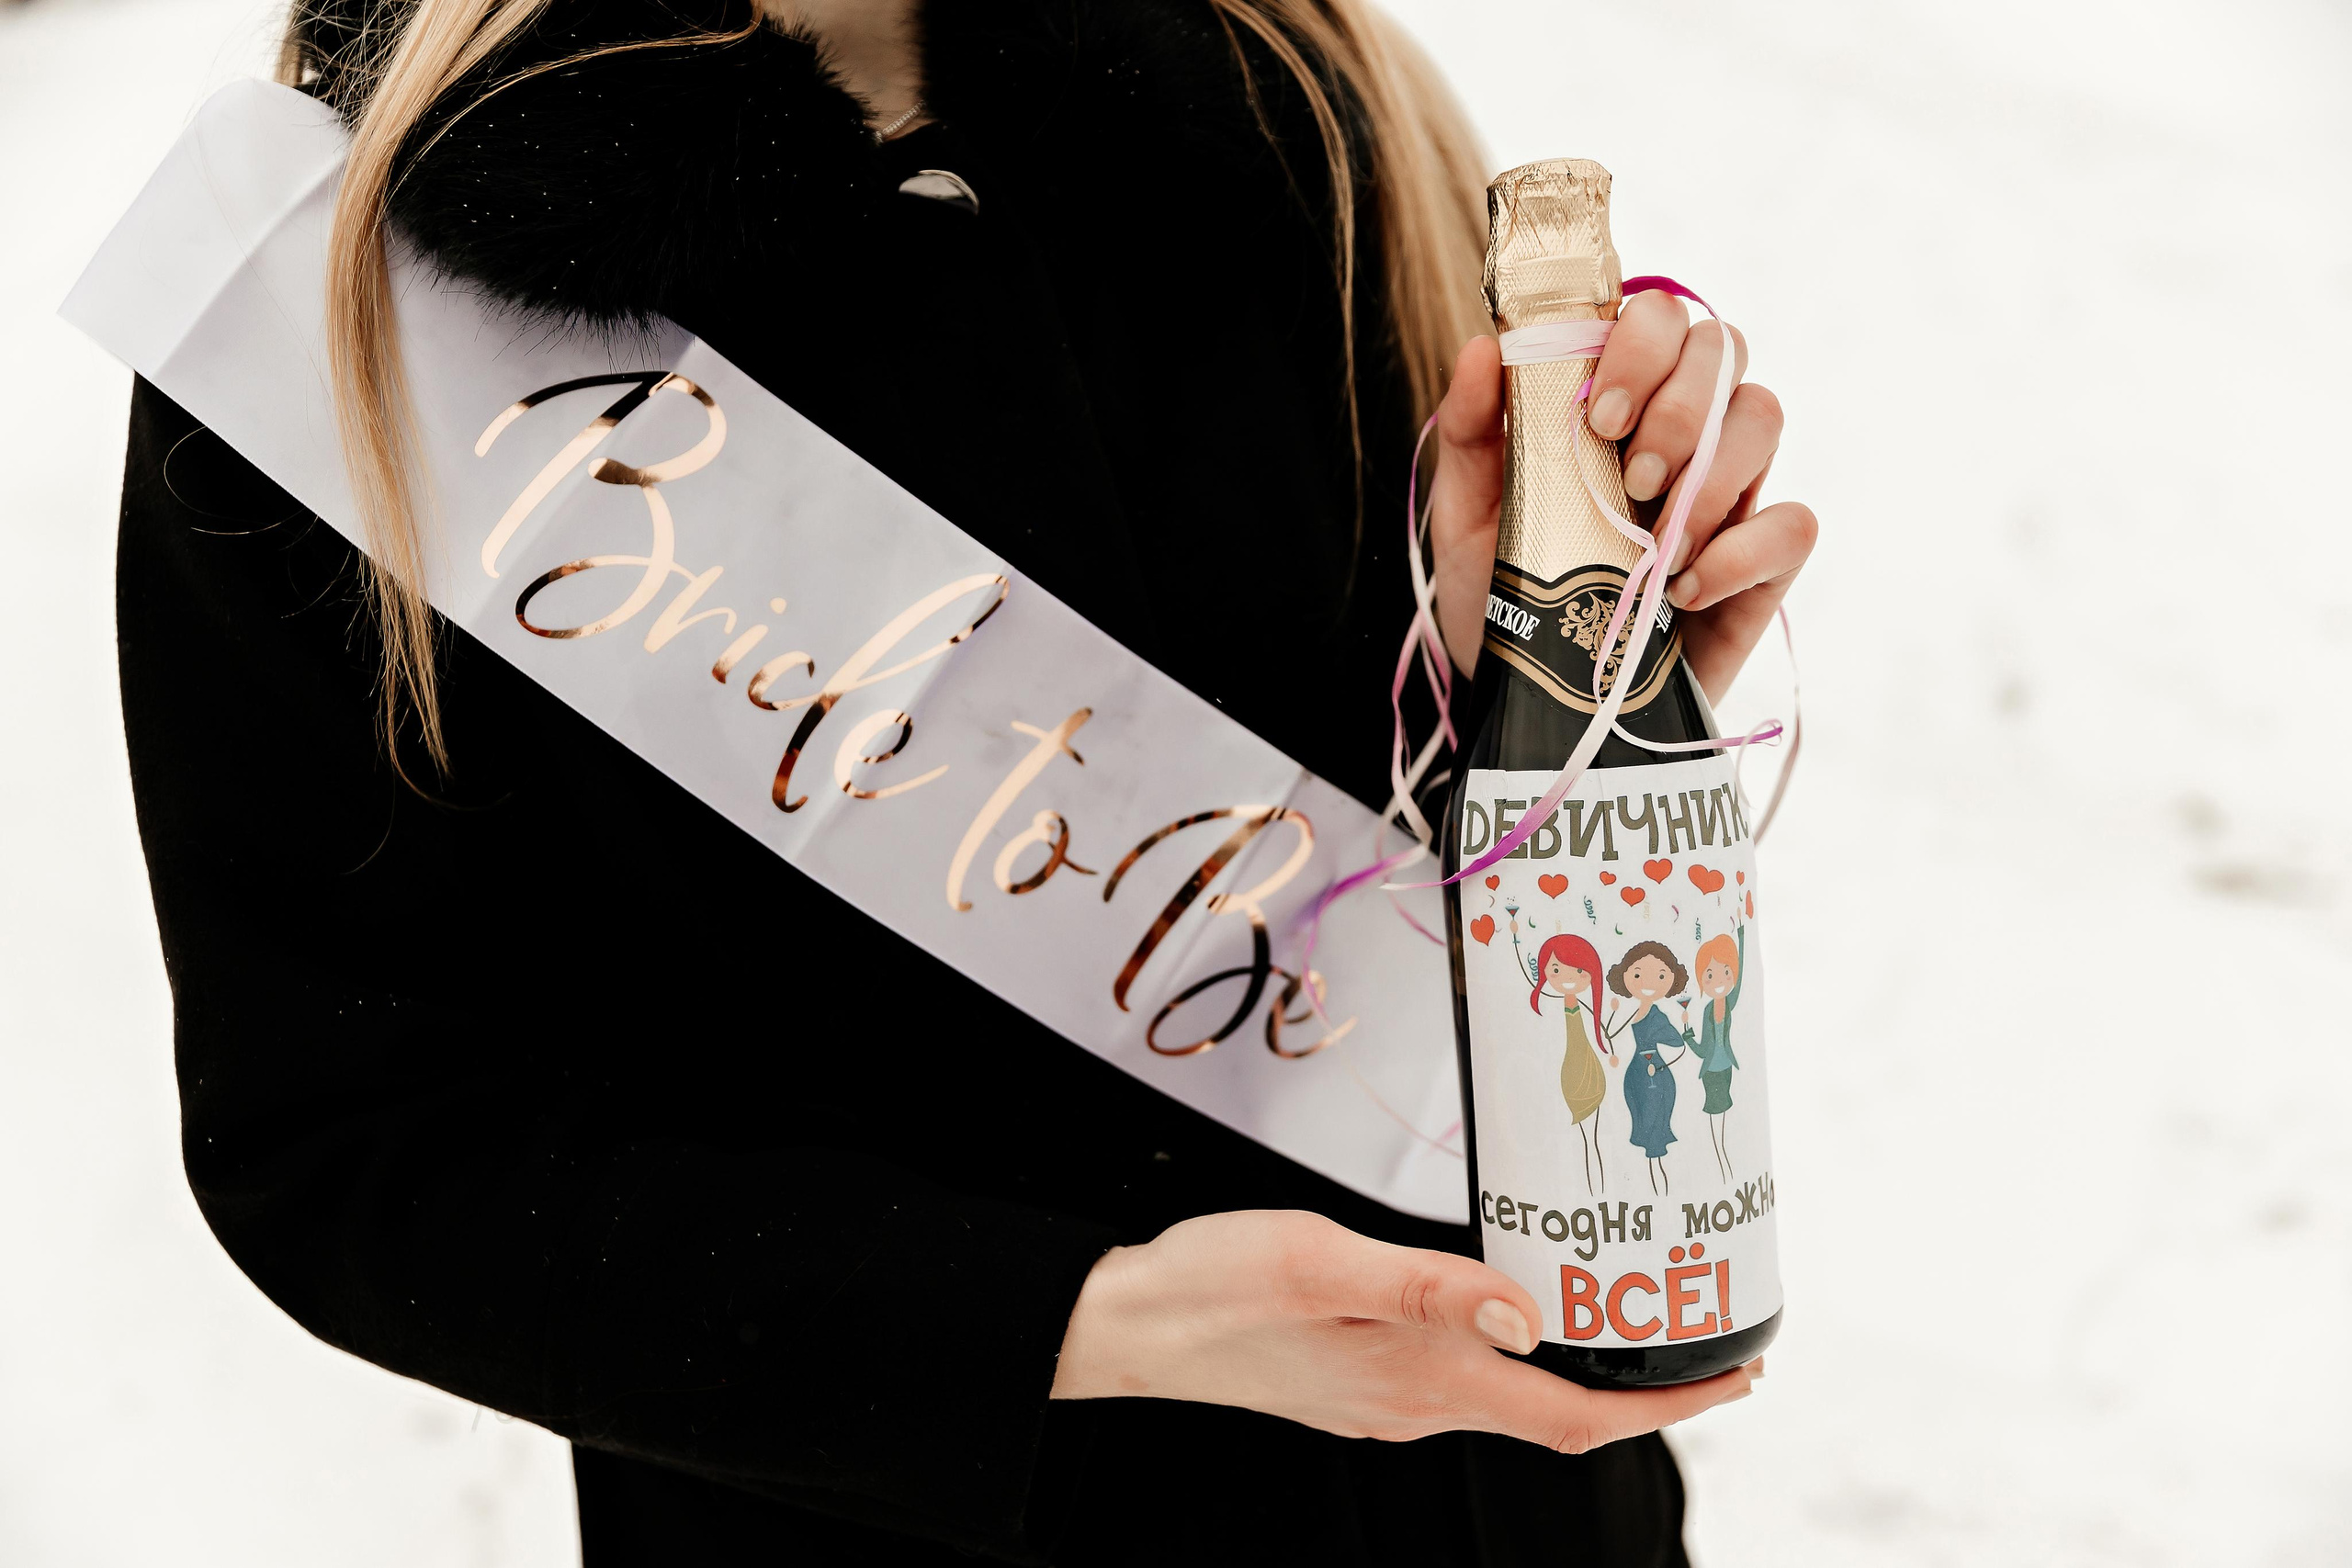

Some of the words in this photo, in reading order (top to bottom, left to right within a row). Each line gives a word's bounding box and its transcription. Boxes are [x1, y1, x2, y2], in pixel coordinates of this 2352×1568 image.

[474, 371, 1009, 813] Bride
[946, 707, 1098, 912] to
[1103, 805, 1358, 1059] Be
[1481, 1190, 1653, 1261] сегодня
[1560, 1242, 1734, 1341] ВСЁ!
